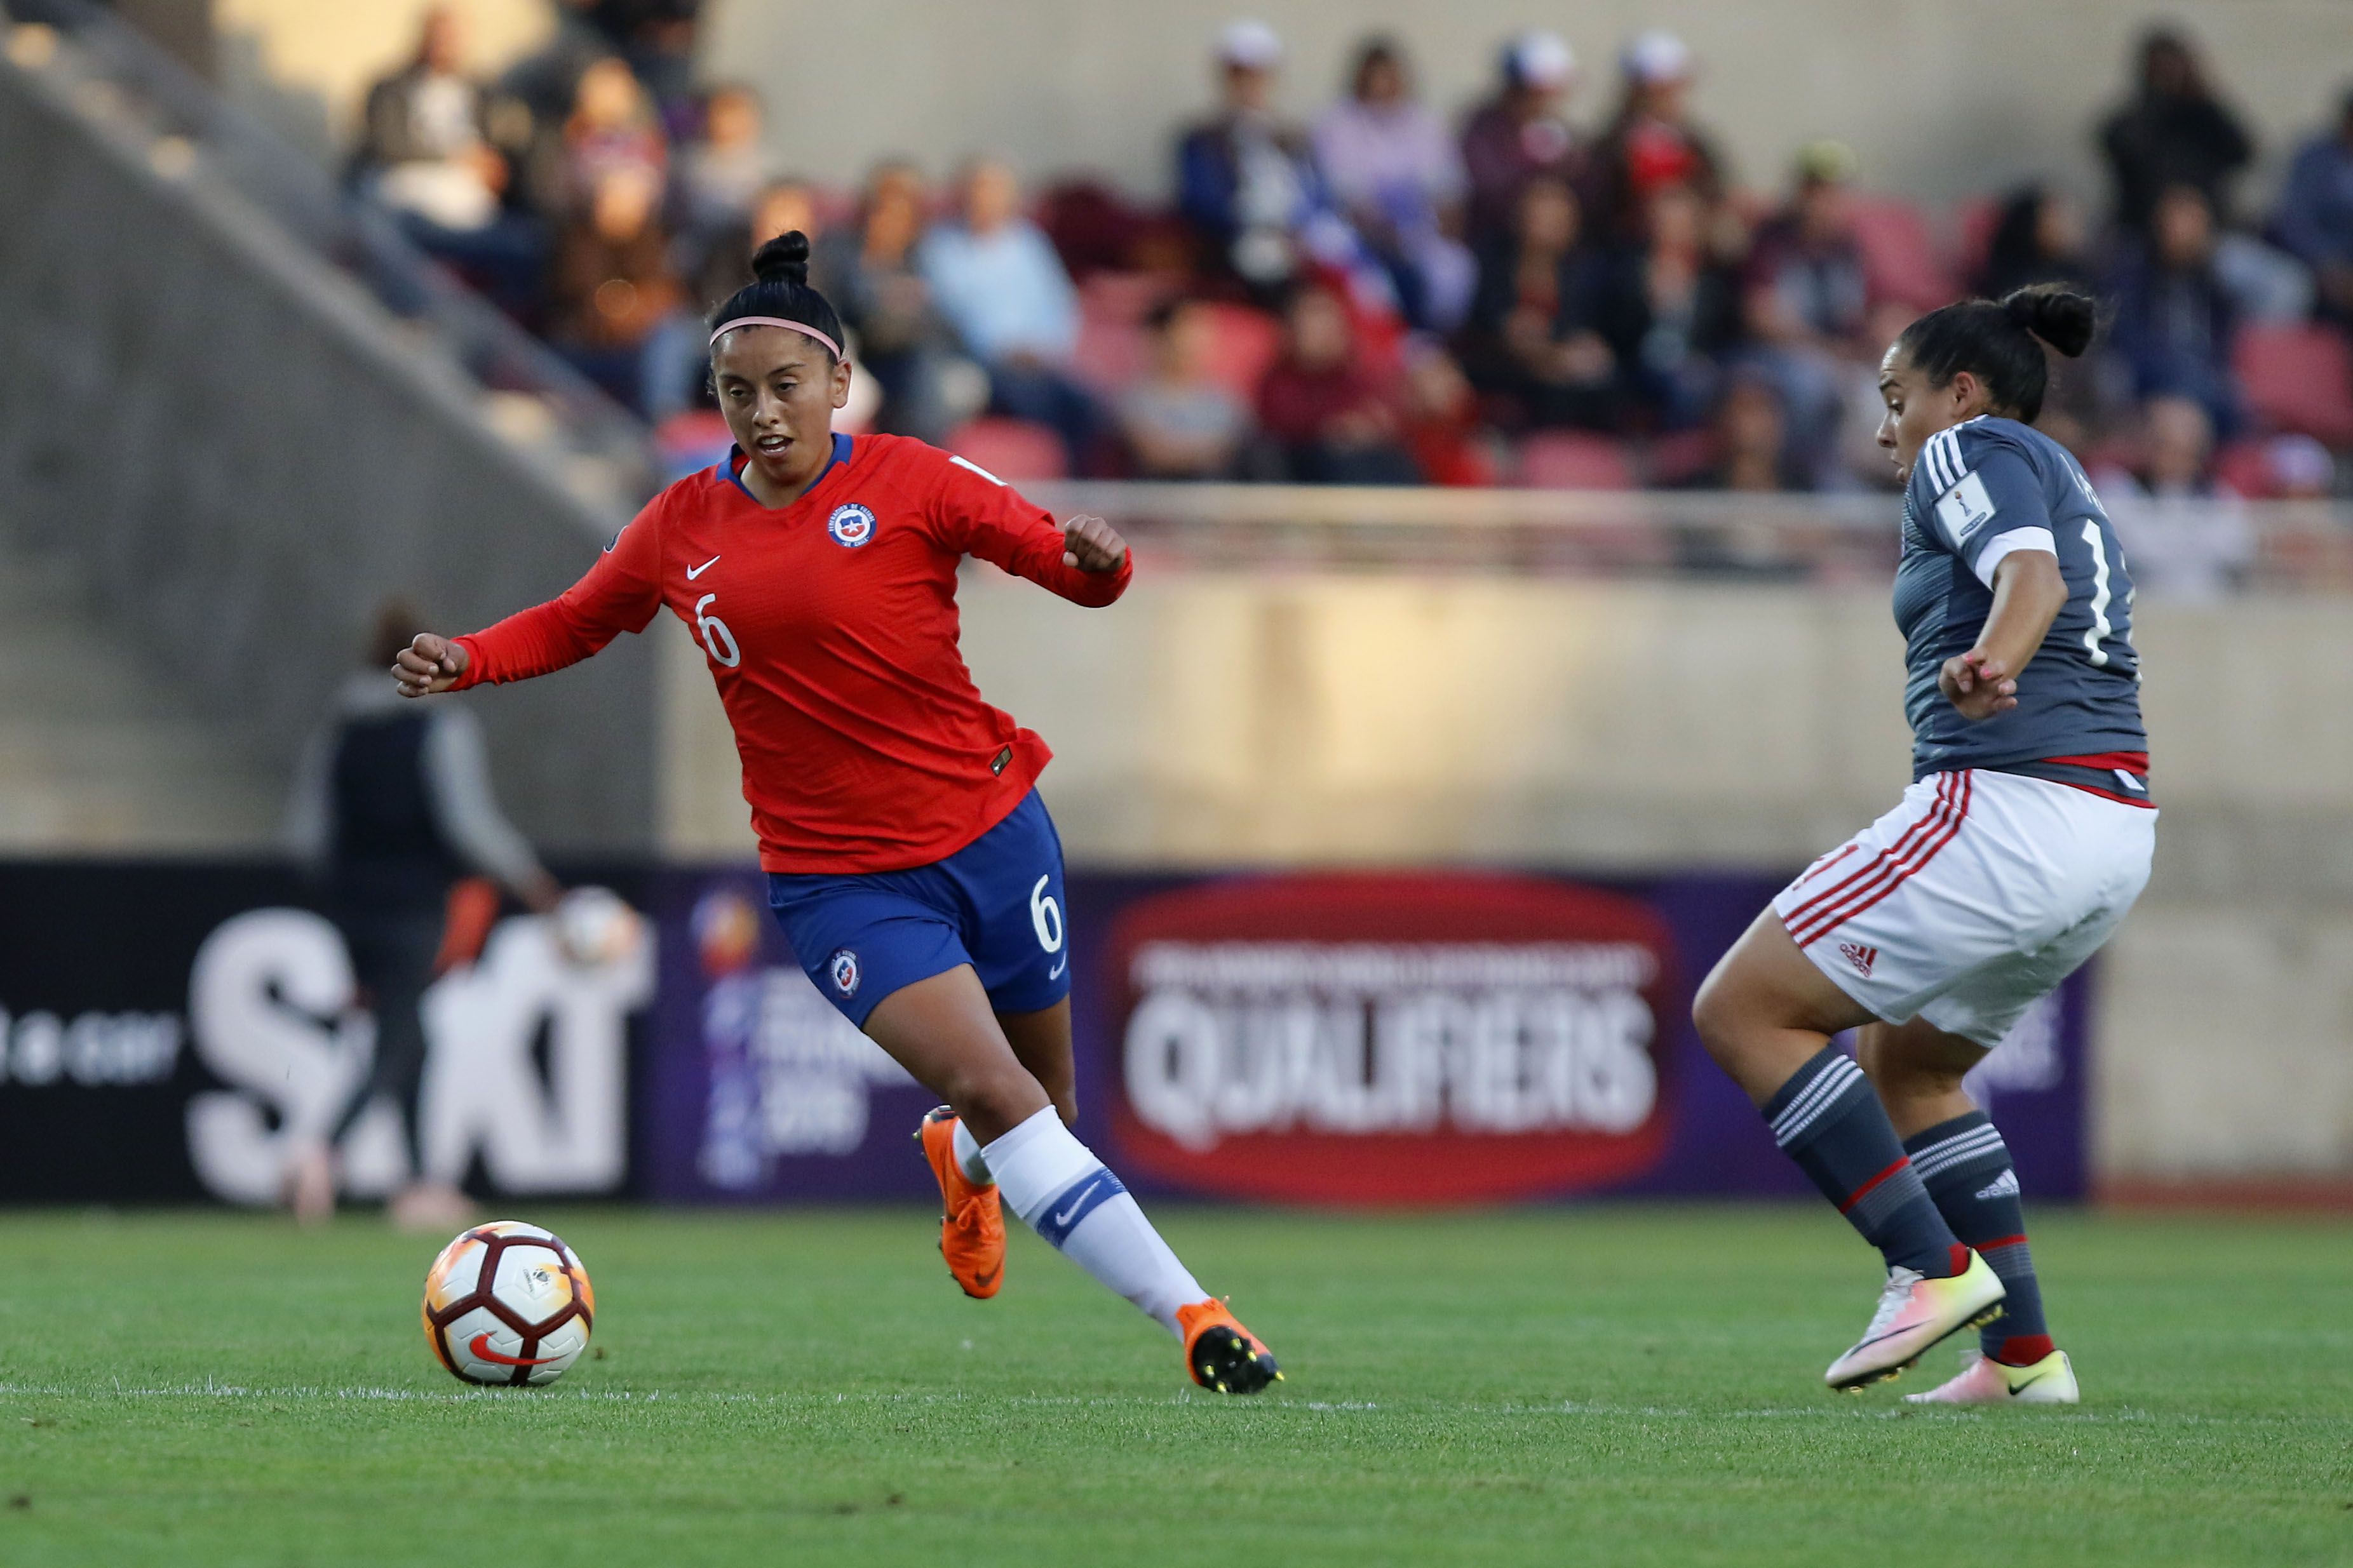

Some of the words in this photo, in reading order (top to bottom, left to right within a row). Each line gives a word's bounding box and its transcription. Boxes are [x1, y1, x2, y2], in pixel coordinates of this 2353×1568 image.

[695, 593, 741, 668] 6
[1029, 873, 1063, 954] 6
[1839, 943, 1873, 979] adidas
[1124, 988, 1658, 1153] QUALIFIERS
